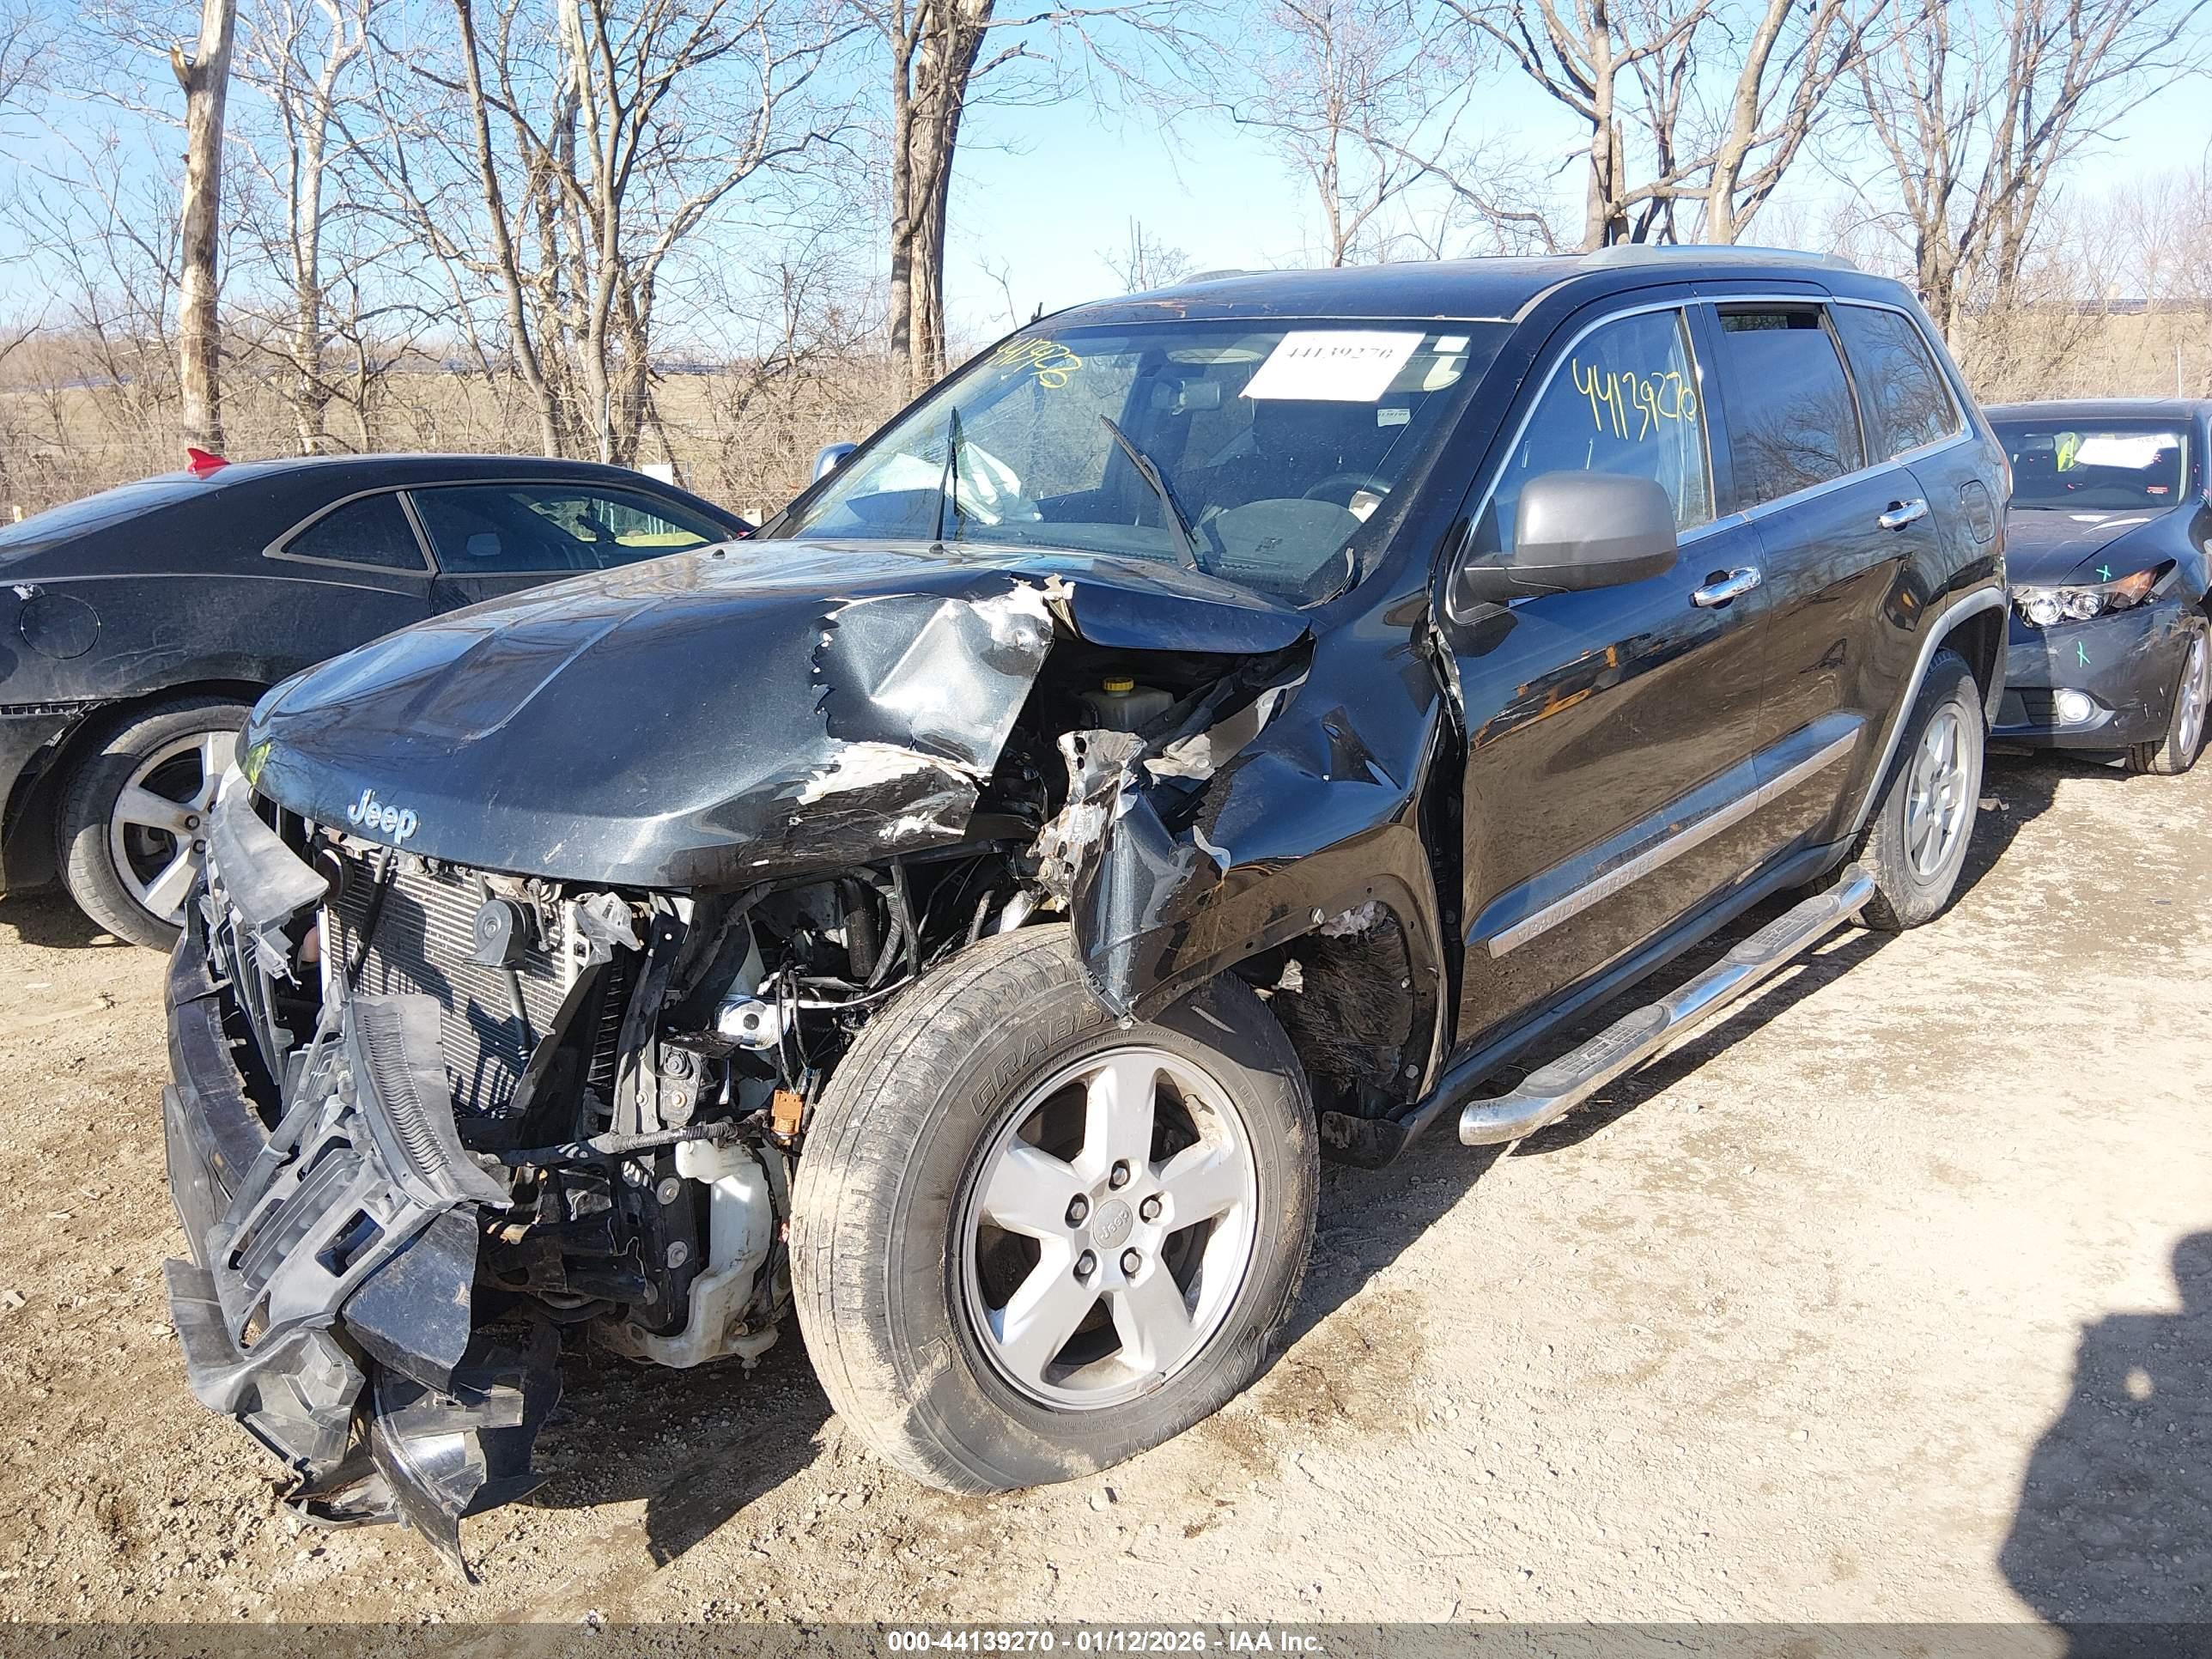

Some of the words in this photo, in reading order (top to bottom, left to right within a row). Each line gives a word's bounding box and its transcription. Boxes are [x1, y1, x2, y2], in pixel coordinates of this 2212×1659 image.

[1571, 357, 1698, 442] 44139270
[347, 787, 420, 846] Jeep
[1516, 902, 1575, 942] GRAND
[1580, 855, 1657, 907] CHEROKEE
[1100, 1209, 1130, 1241] Jeep
